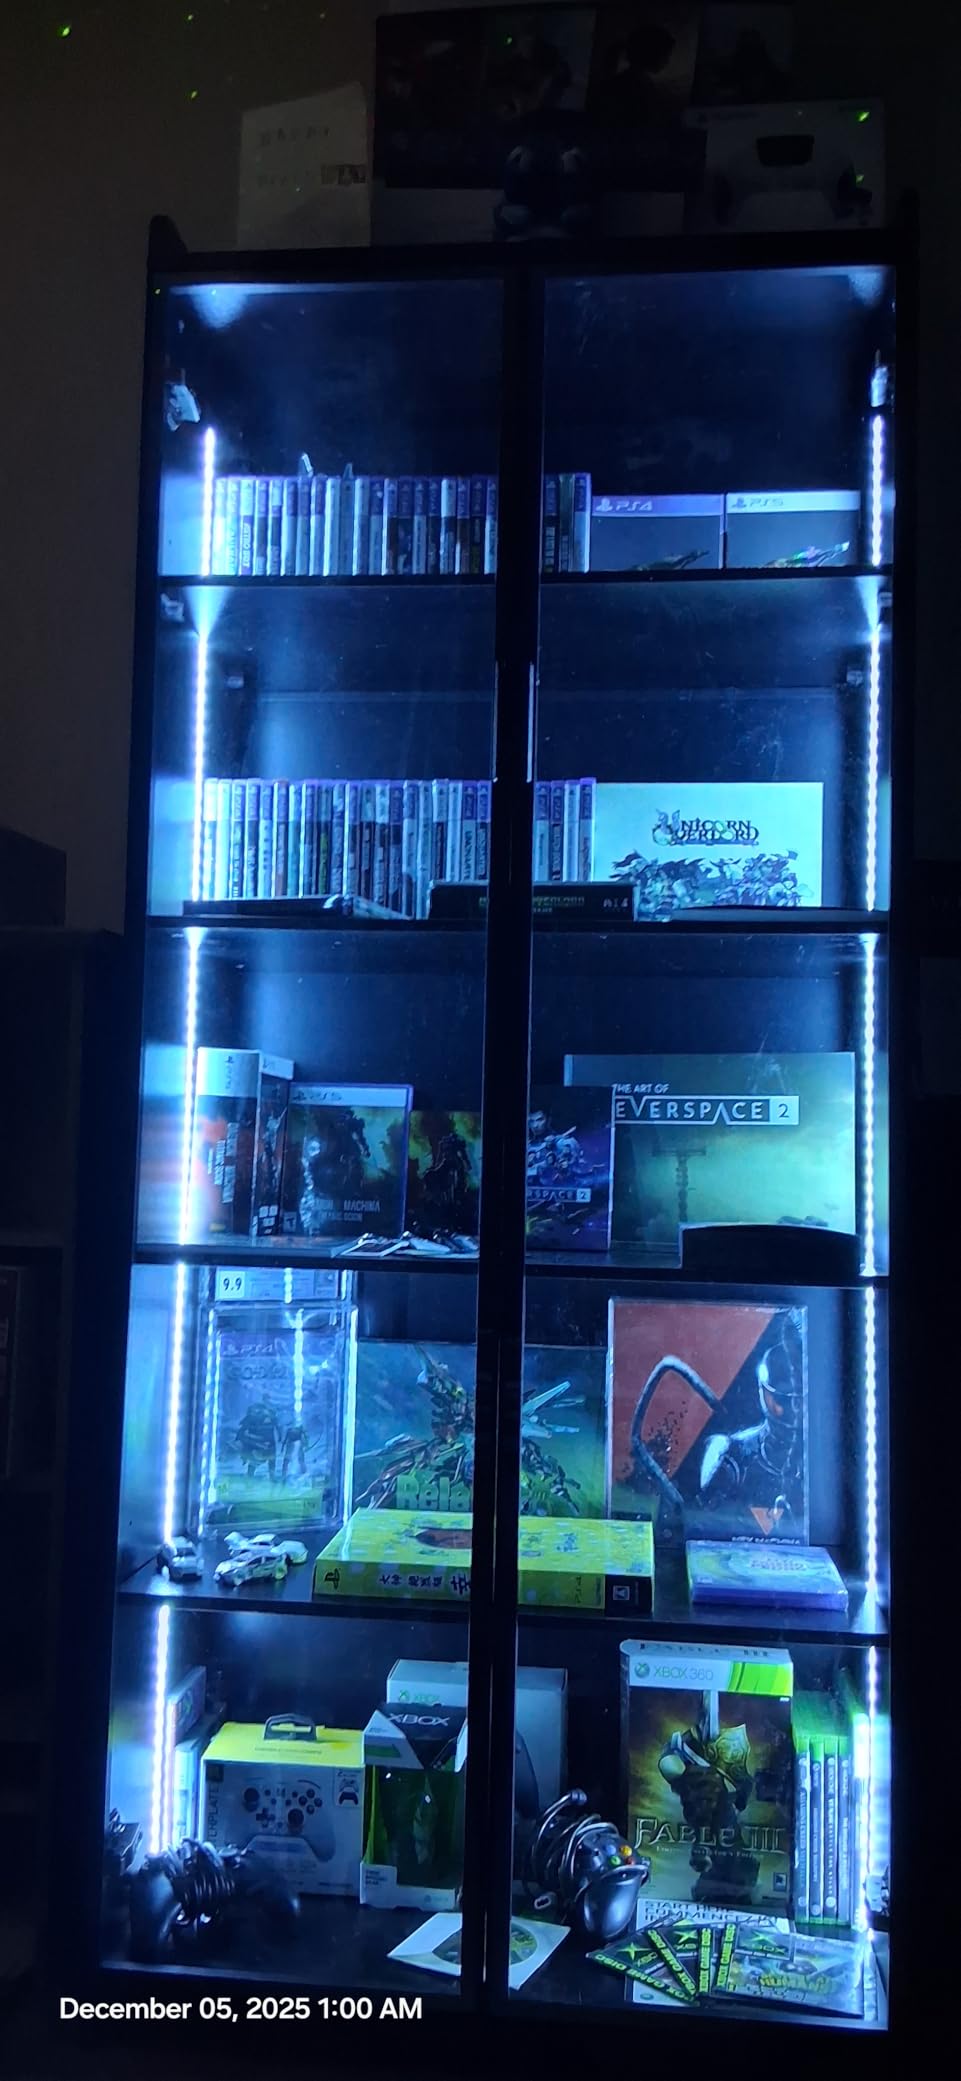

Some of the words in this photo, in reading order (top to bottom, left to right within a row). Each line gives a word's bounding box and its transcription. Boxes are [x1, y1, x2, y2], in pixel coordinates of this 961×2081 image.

[615, 500, 653, 512] PS4
[612, 1084, 632, 1093] THE
[633, 1084, 653, 1093] ART
[654, 1084, 670, 1093] OF
[616, 1098, 764, 1122] EVERSPACE
[778, 1103, 790, 1118] 2
[222, 1277, 243, 1291] 9.9
[653, 1665, 689, 1680] XBOX
[690, 1668, 714, 1681] 360
[388, 1713, 450, 1726] XBOX
[634, 1818, 737, 1849] FABLE
[743, 1826, 787, 1855] III
